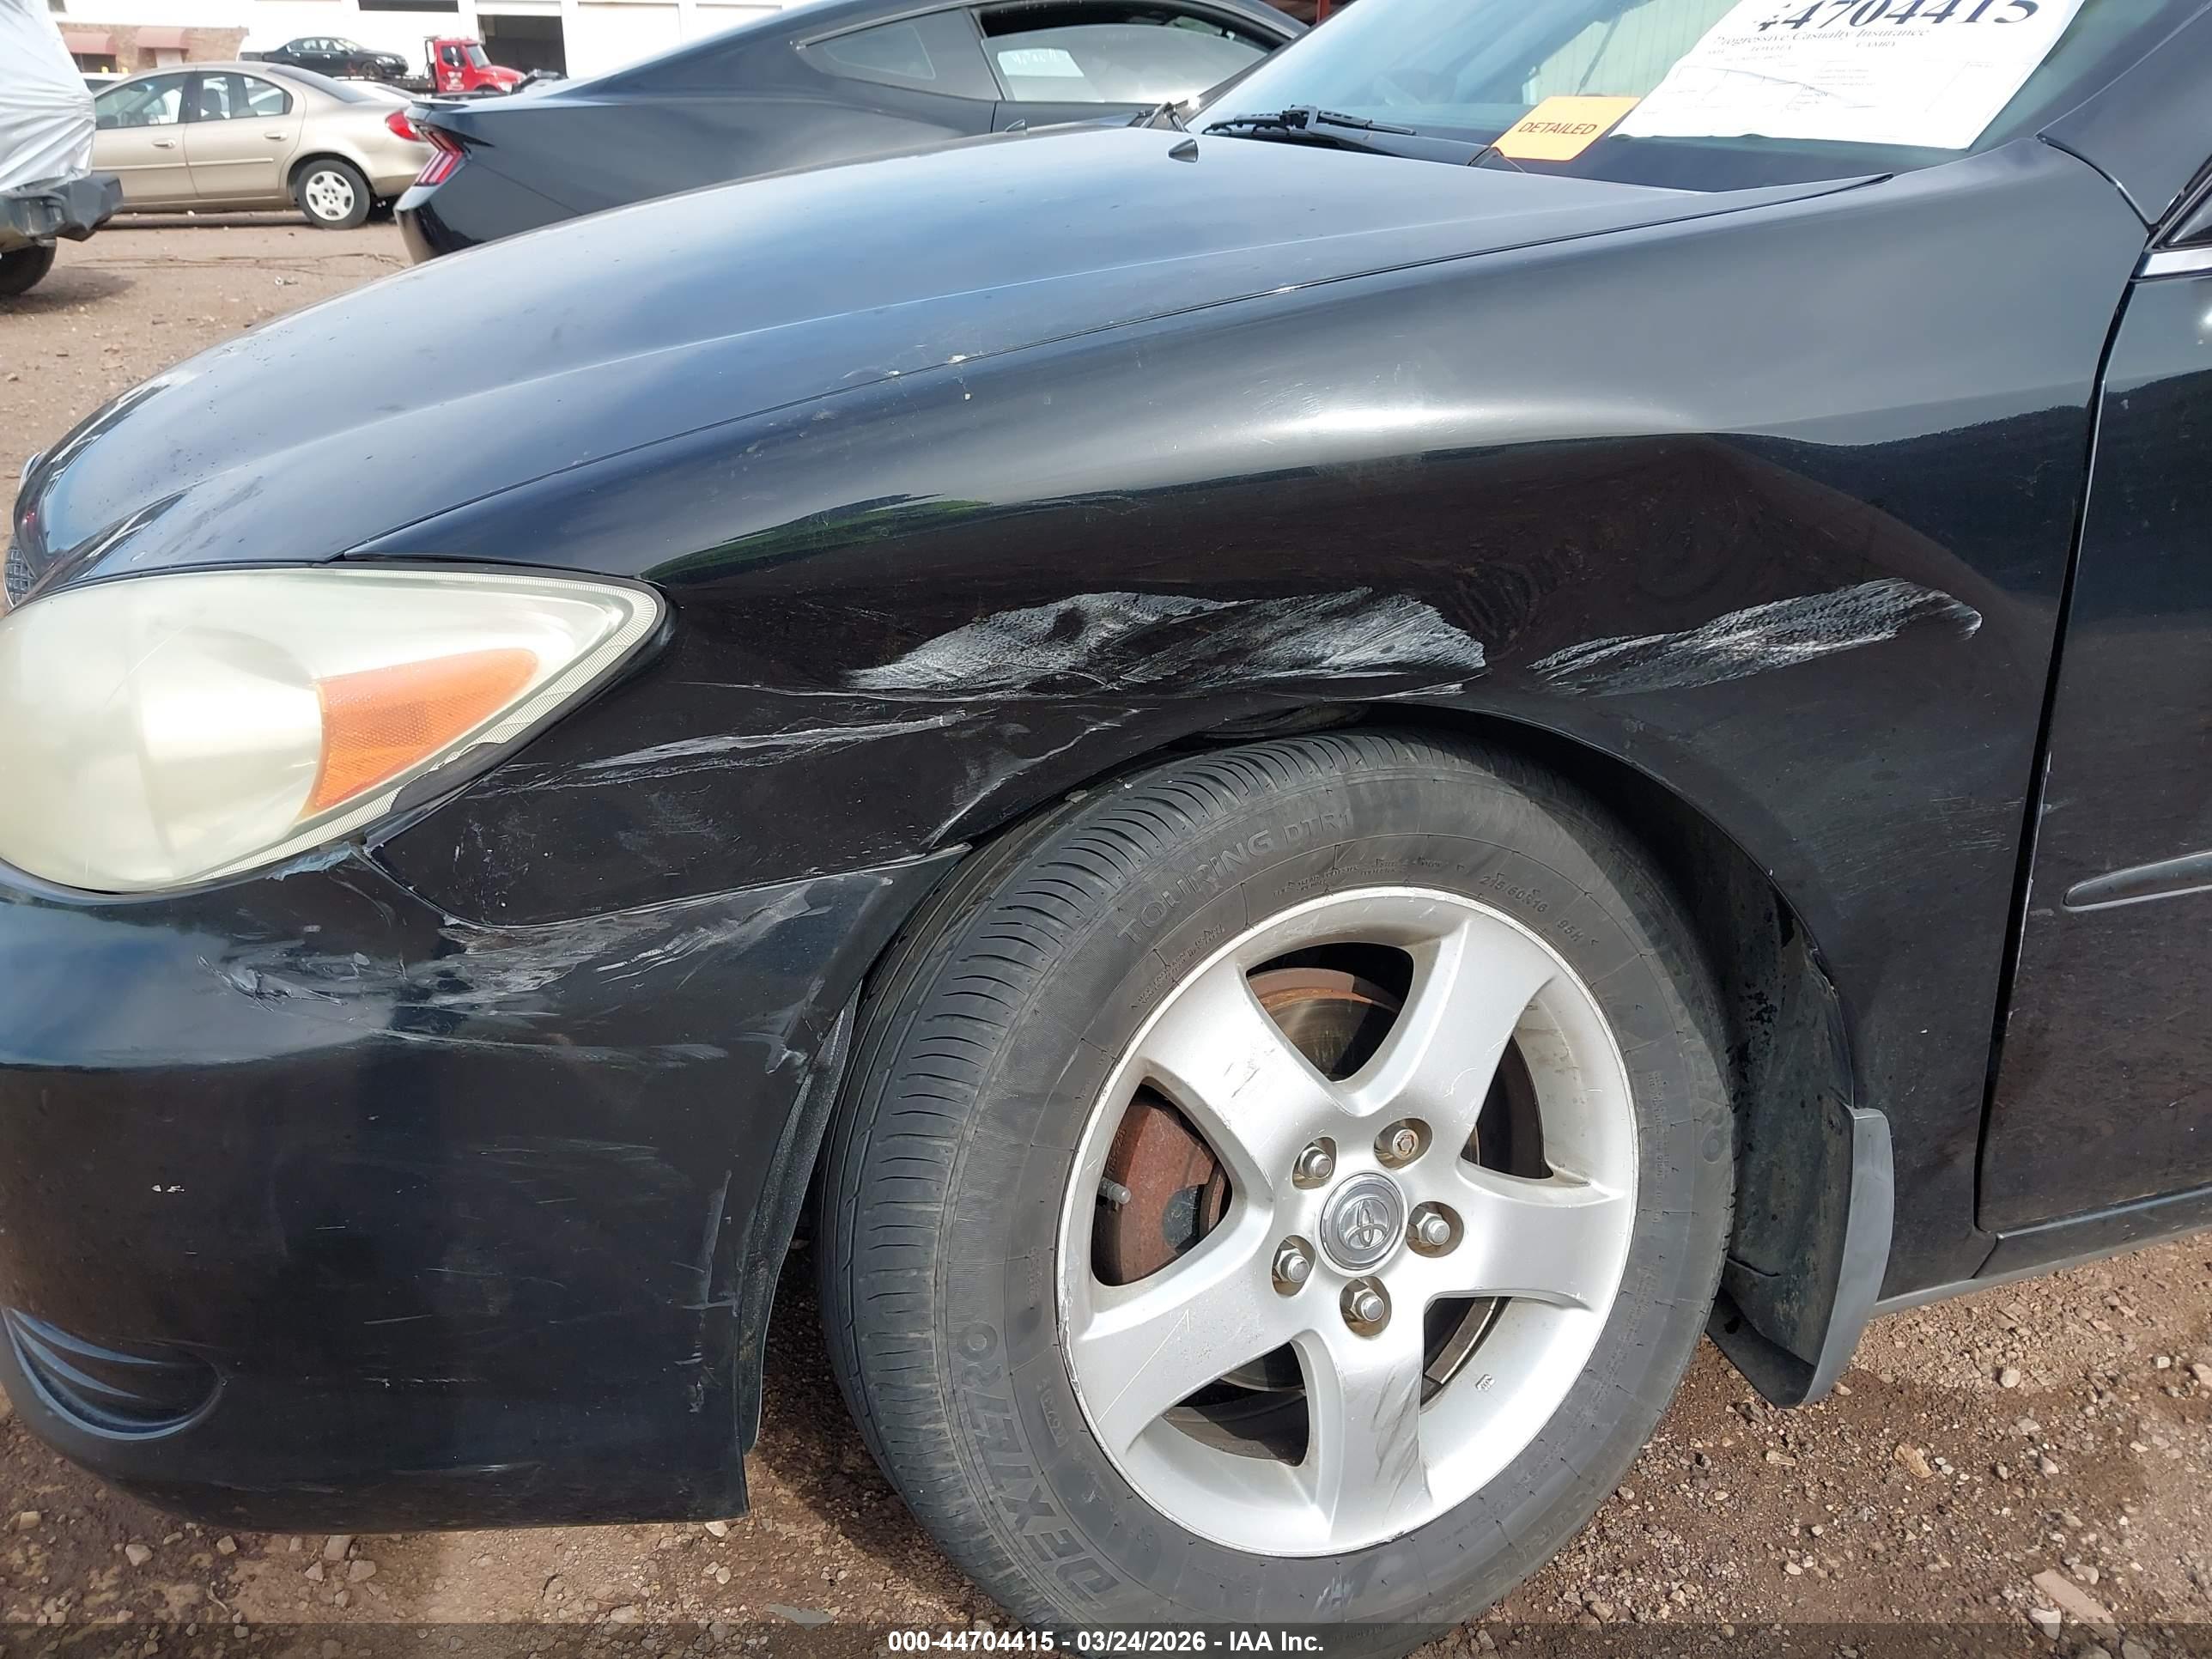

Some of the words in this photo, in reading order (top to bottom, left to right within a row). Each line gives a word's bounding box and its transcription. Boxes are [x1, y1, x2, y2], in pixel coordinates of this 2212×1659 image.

[1792, 29, 1850, 42] Casualty
[1856, 28, 1930, 39] Insurance
[1518, 122, 1598, 135] DETAILED
[1117, 830, 1273, 943] TOURING
